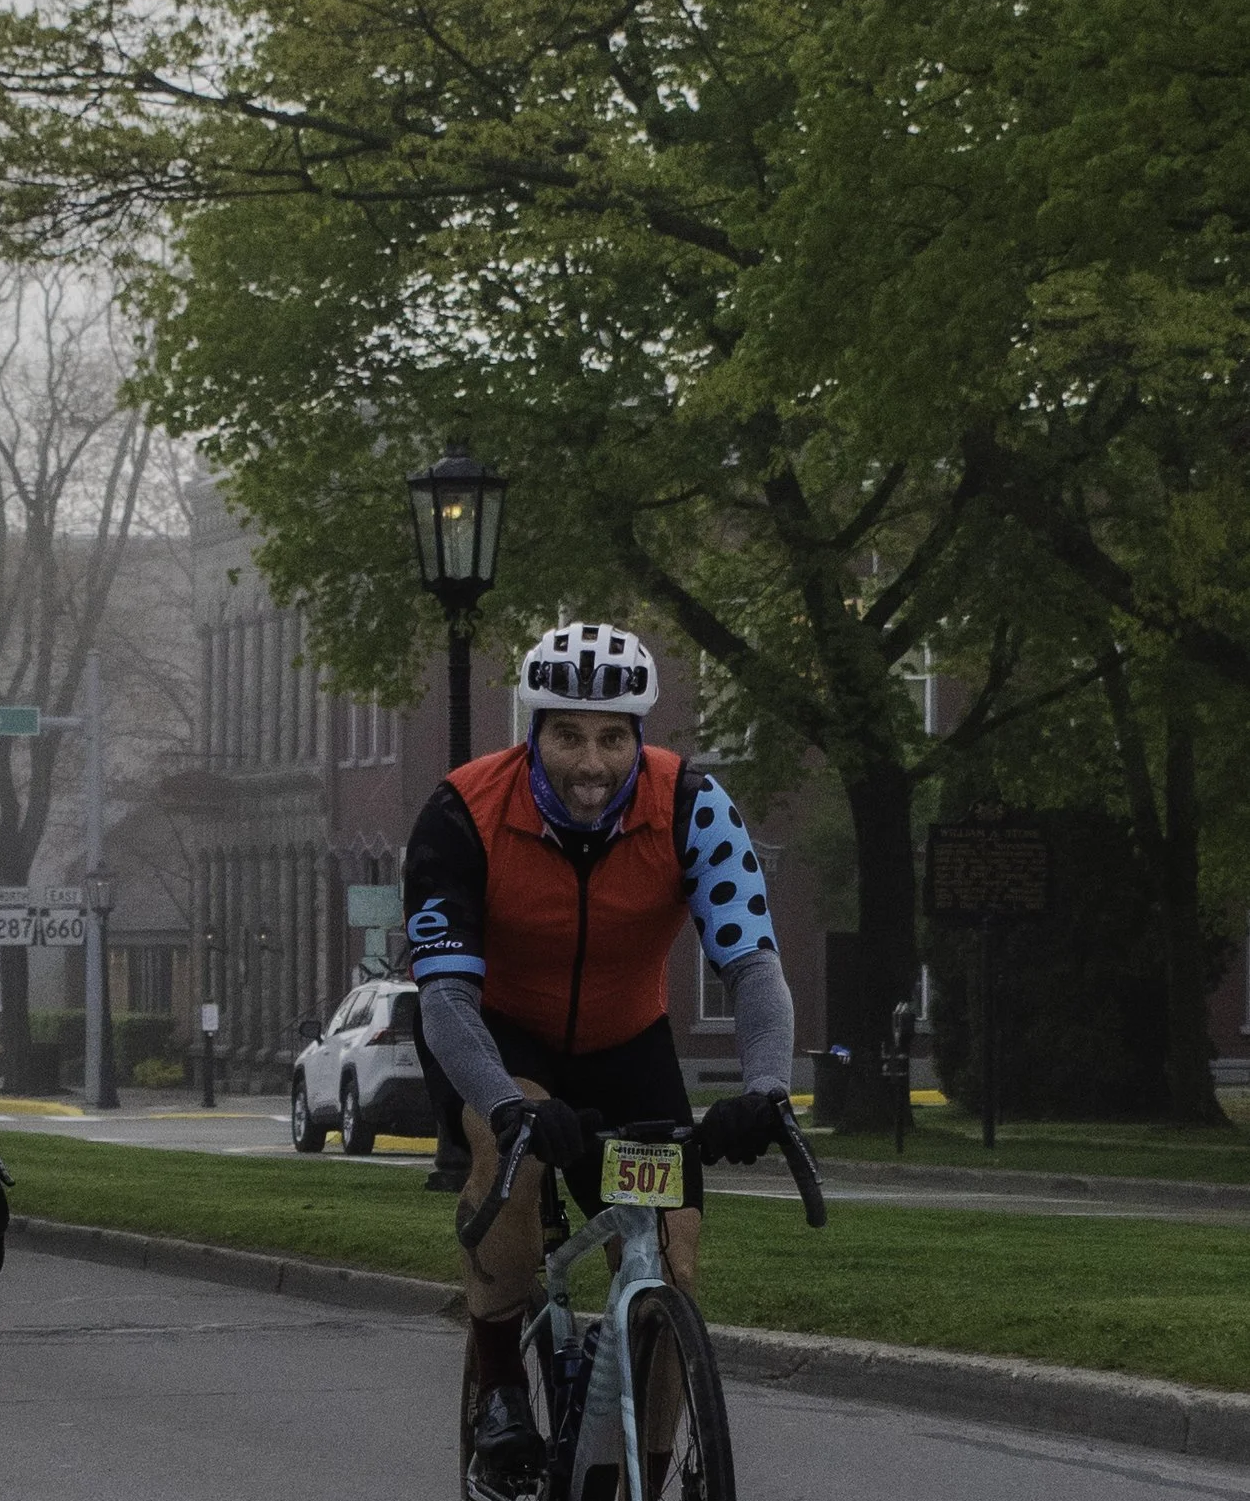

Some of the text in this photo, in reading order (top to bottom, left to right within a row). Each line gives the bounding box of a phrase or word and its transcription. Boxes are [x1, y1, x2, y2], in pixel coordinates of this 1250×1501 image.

[49, 889, 80, 903] EAST
[45, 918, 84, 939] 660
[410, 940, 464, 956] ervélo
[617, 1160, 671, 1194] 507
